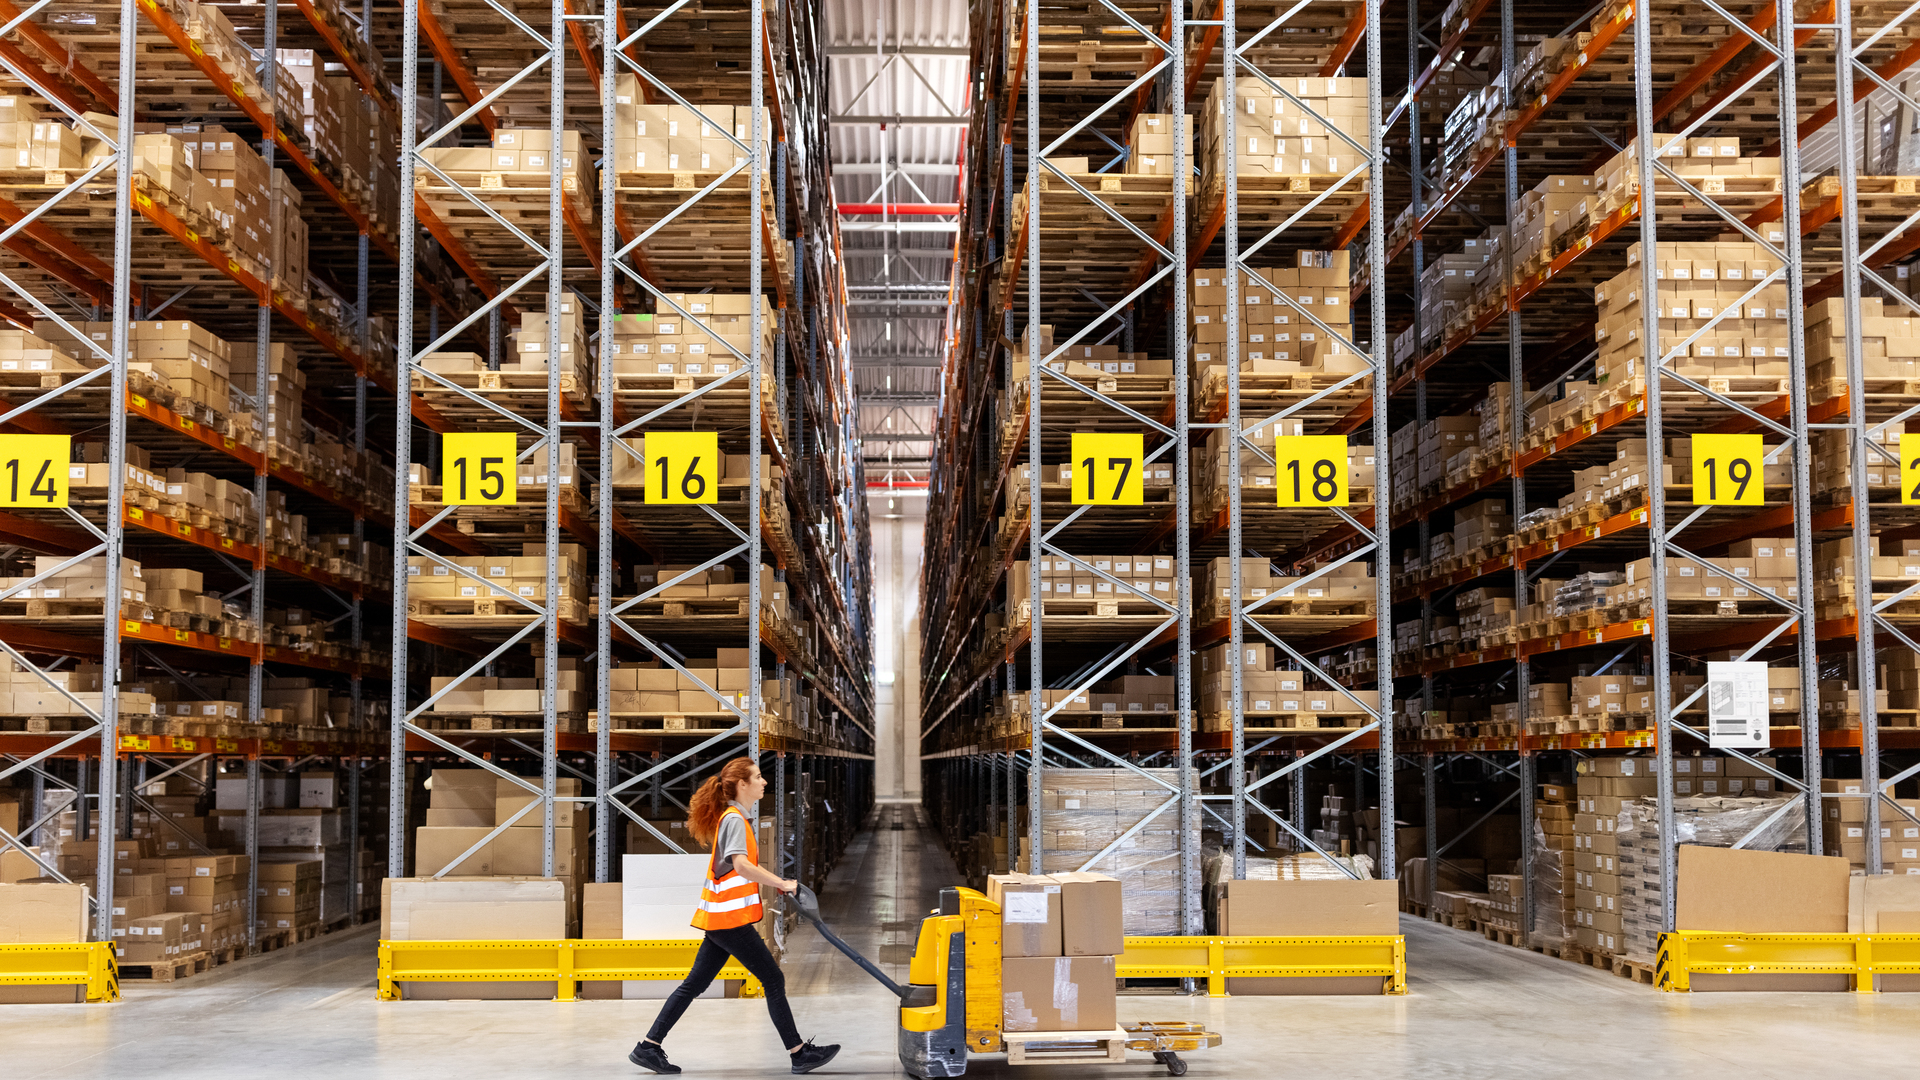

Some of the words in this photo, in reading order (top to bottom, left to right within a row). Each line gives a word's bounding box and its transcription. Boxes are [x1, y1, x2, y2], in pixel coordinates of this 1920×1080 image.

[7, 460, 57, 502] 14
[454, 458, 503, 500] 15
[656, 457, 705, 499] 16
[1083, 458, 1132, 500] 17
[1288, 460, 1337, 502] 18
[1704, 458, 1751, 500] 19
